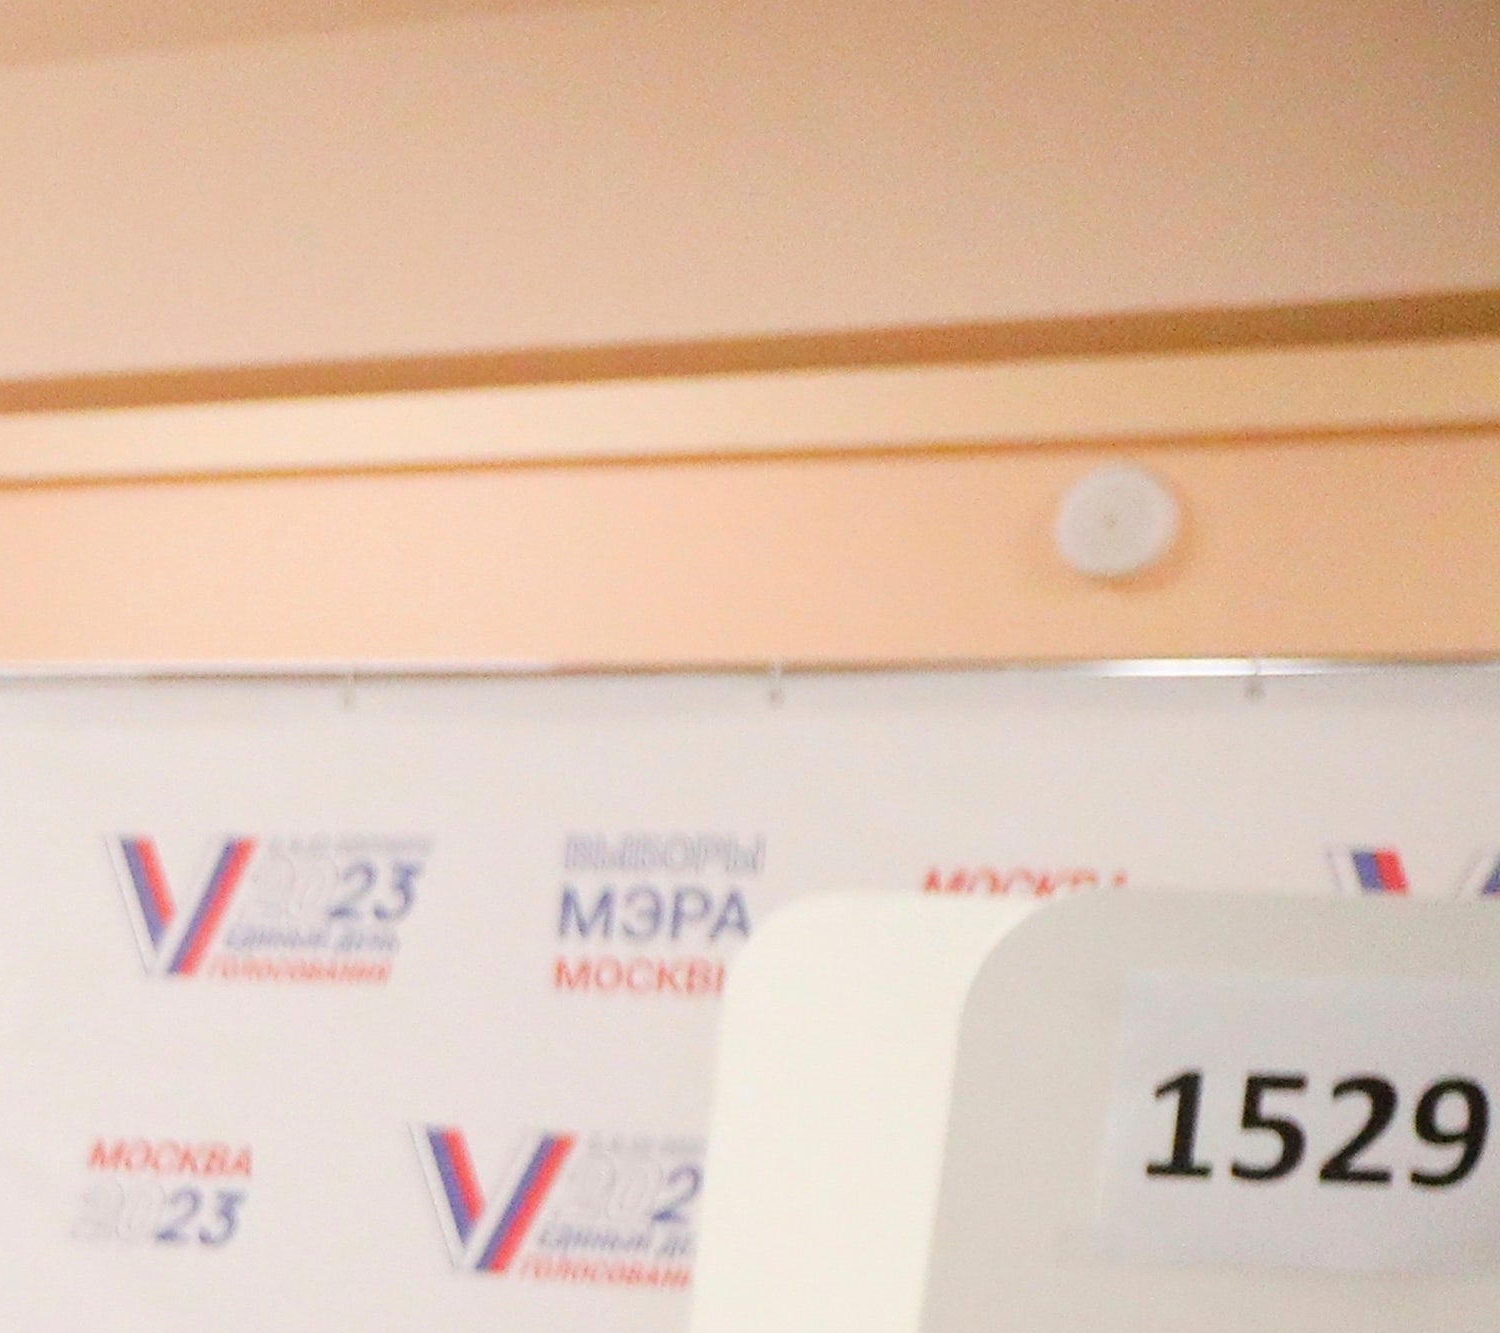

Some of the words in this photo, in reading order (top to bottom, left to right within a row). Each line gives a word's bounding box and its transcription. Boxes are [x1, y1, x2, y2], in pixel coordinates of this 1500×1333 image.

[563, 832, 767, 876] ВЫБОРЫ
[556, 884, 752, 941] МЭРА
[1146, 1068, 1491, 1188] 1529
[87, 1136, 255, 1179] МОСКВА
